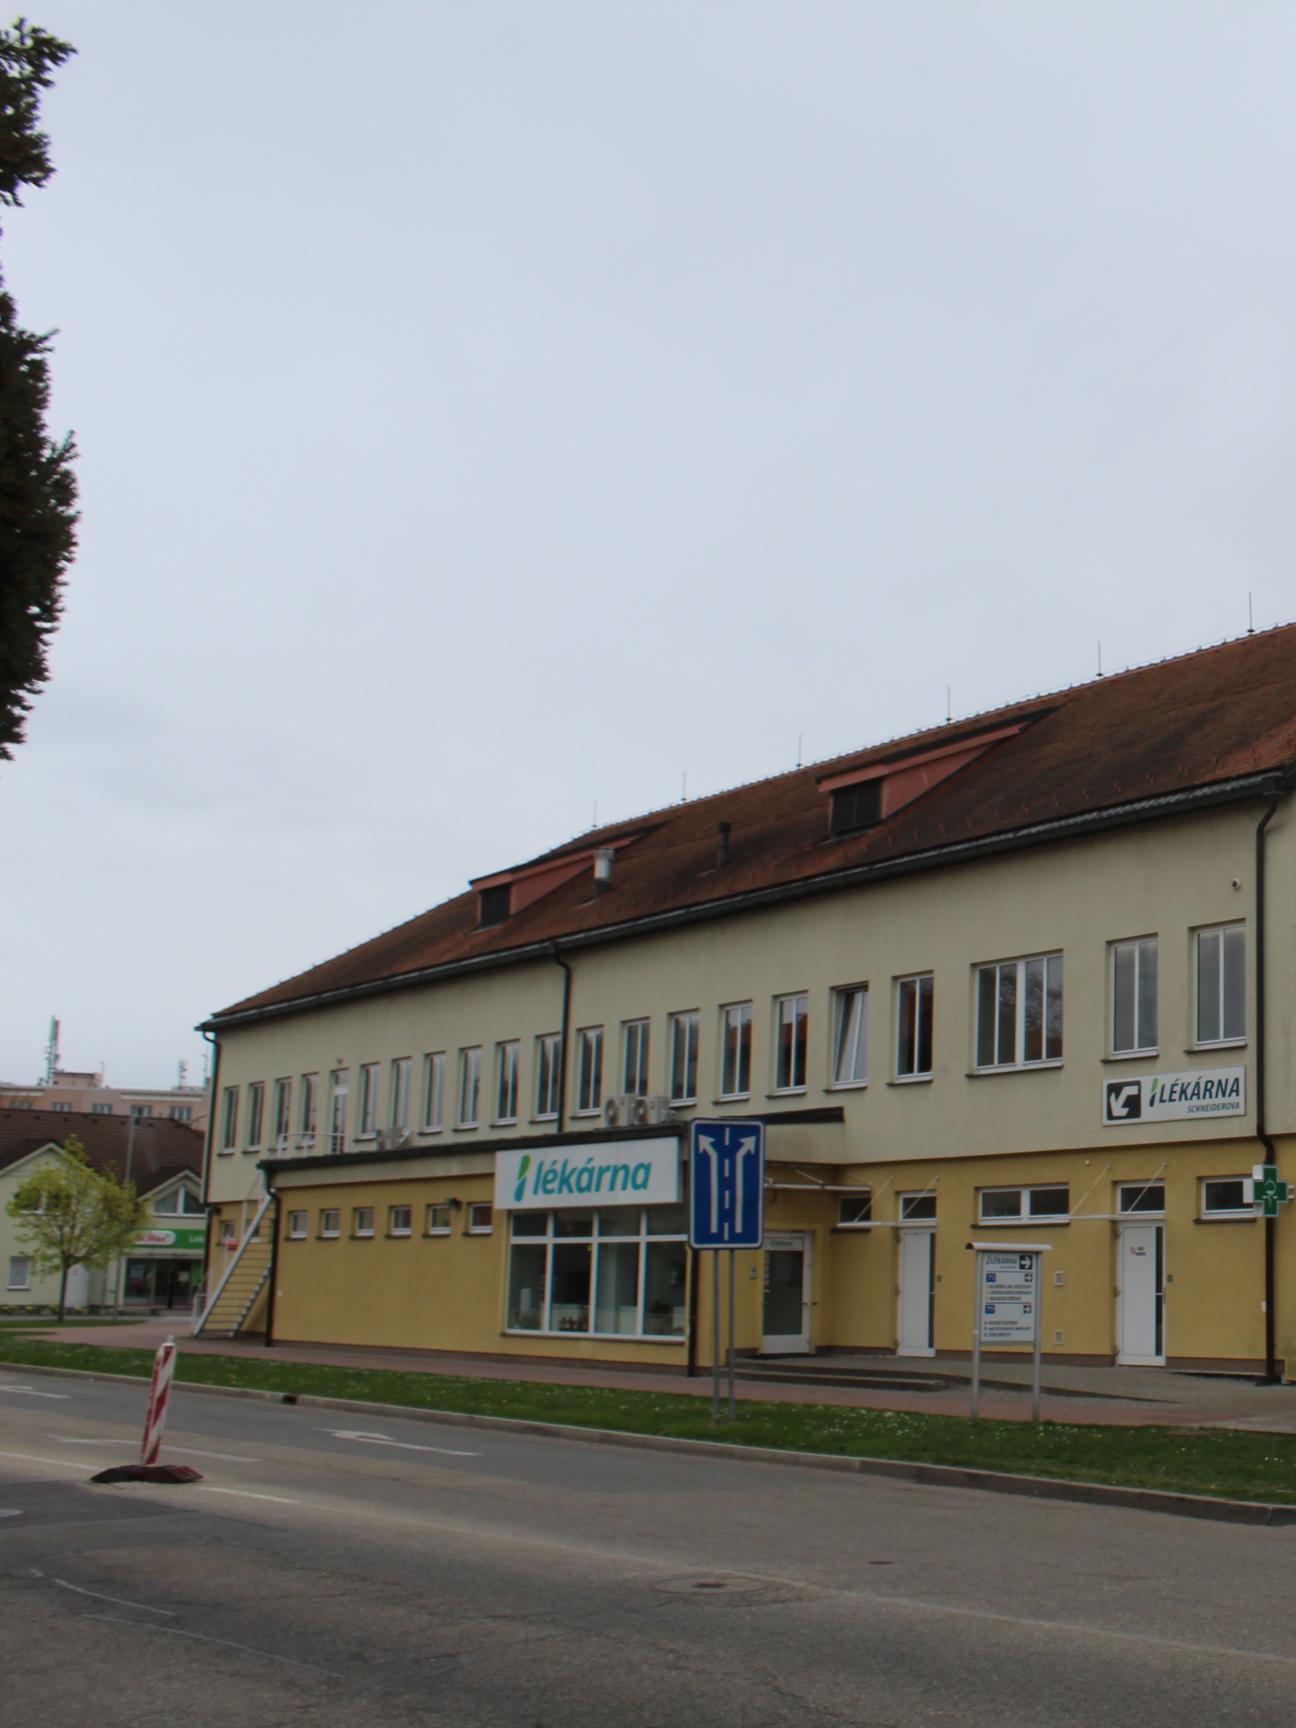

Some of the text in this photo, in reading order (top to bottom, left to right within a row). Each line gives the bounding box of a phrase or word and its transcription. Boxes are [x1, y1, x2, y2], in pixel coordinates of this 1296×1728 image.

[1159, 1076, 1240, 1104] LÉKÁRNA
[1187, 1101, 1240, 1114] SCHNEIDEROVA
[532, 1157, 651, 1196] lékárna
